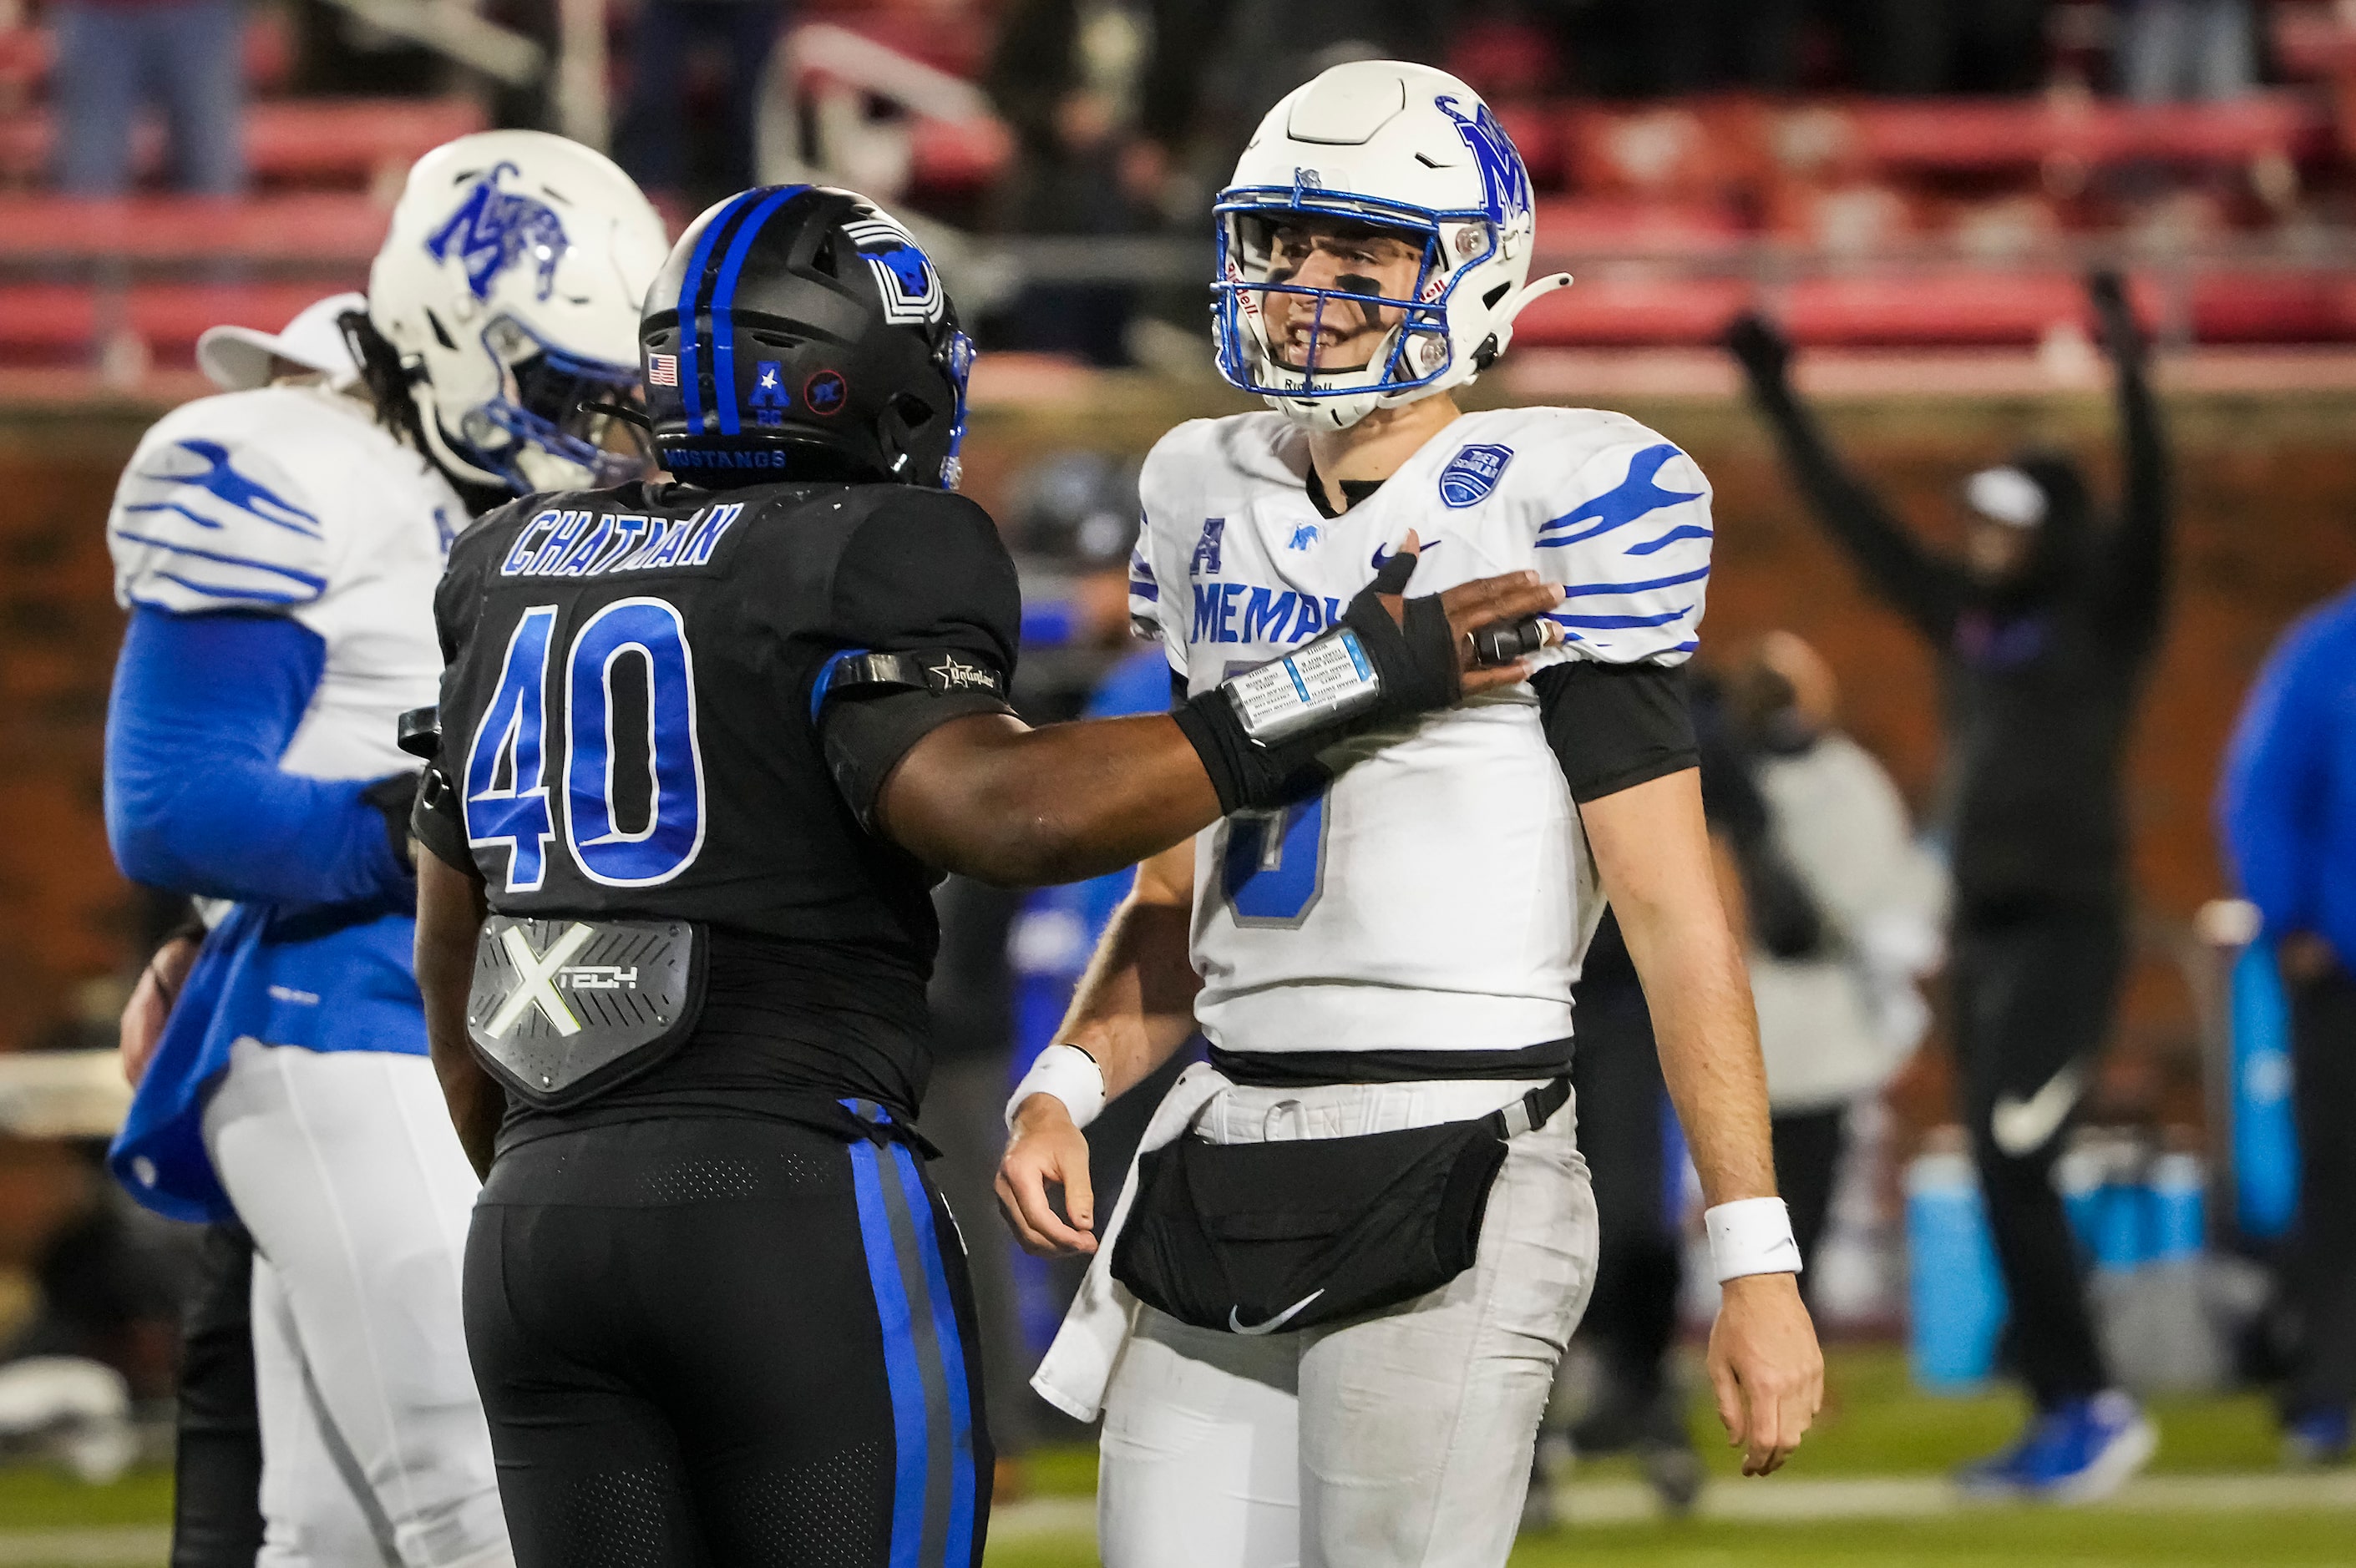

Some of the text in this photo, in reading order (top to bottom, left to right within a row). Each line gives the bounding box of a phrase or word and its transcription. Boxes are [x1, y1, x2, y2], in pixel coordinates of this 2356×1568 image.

[663, 448, 787, 468] MUSTANGS
[501, 502, 744, 578] CHATMAN
[464, 595, 707, 894] 40
